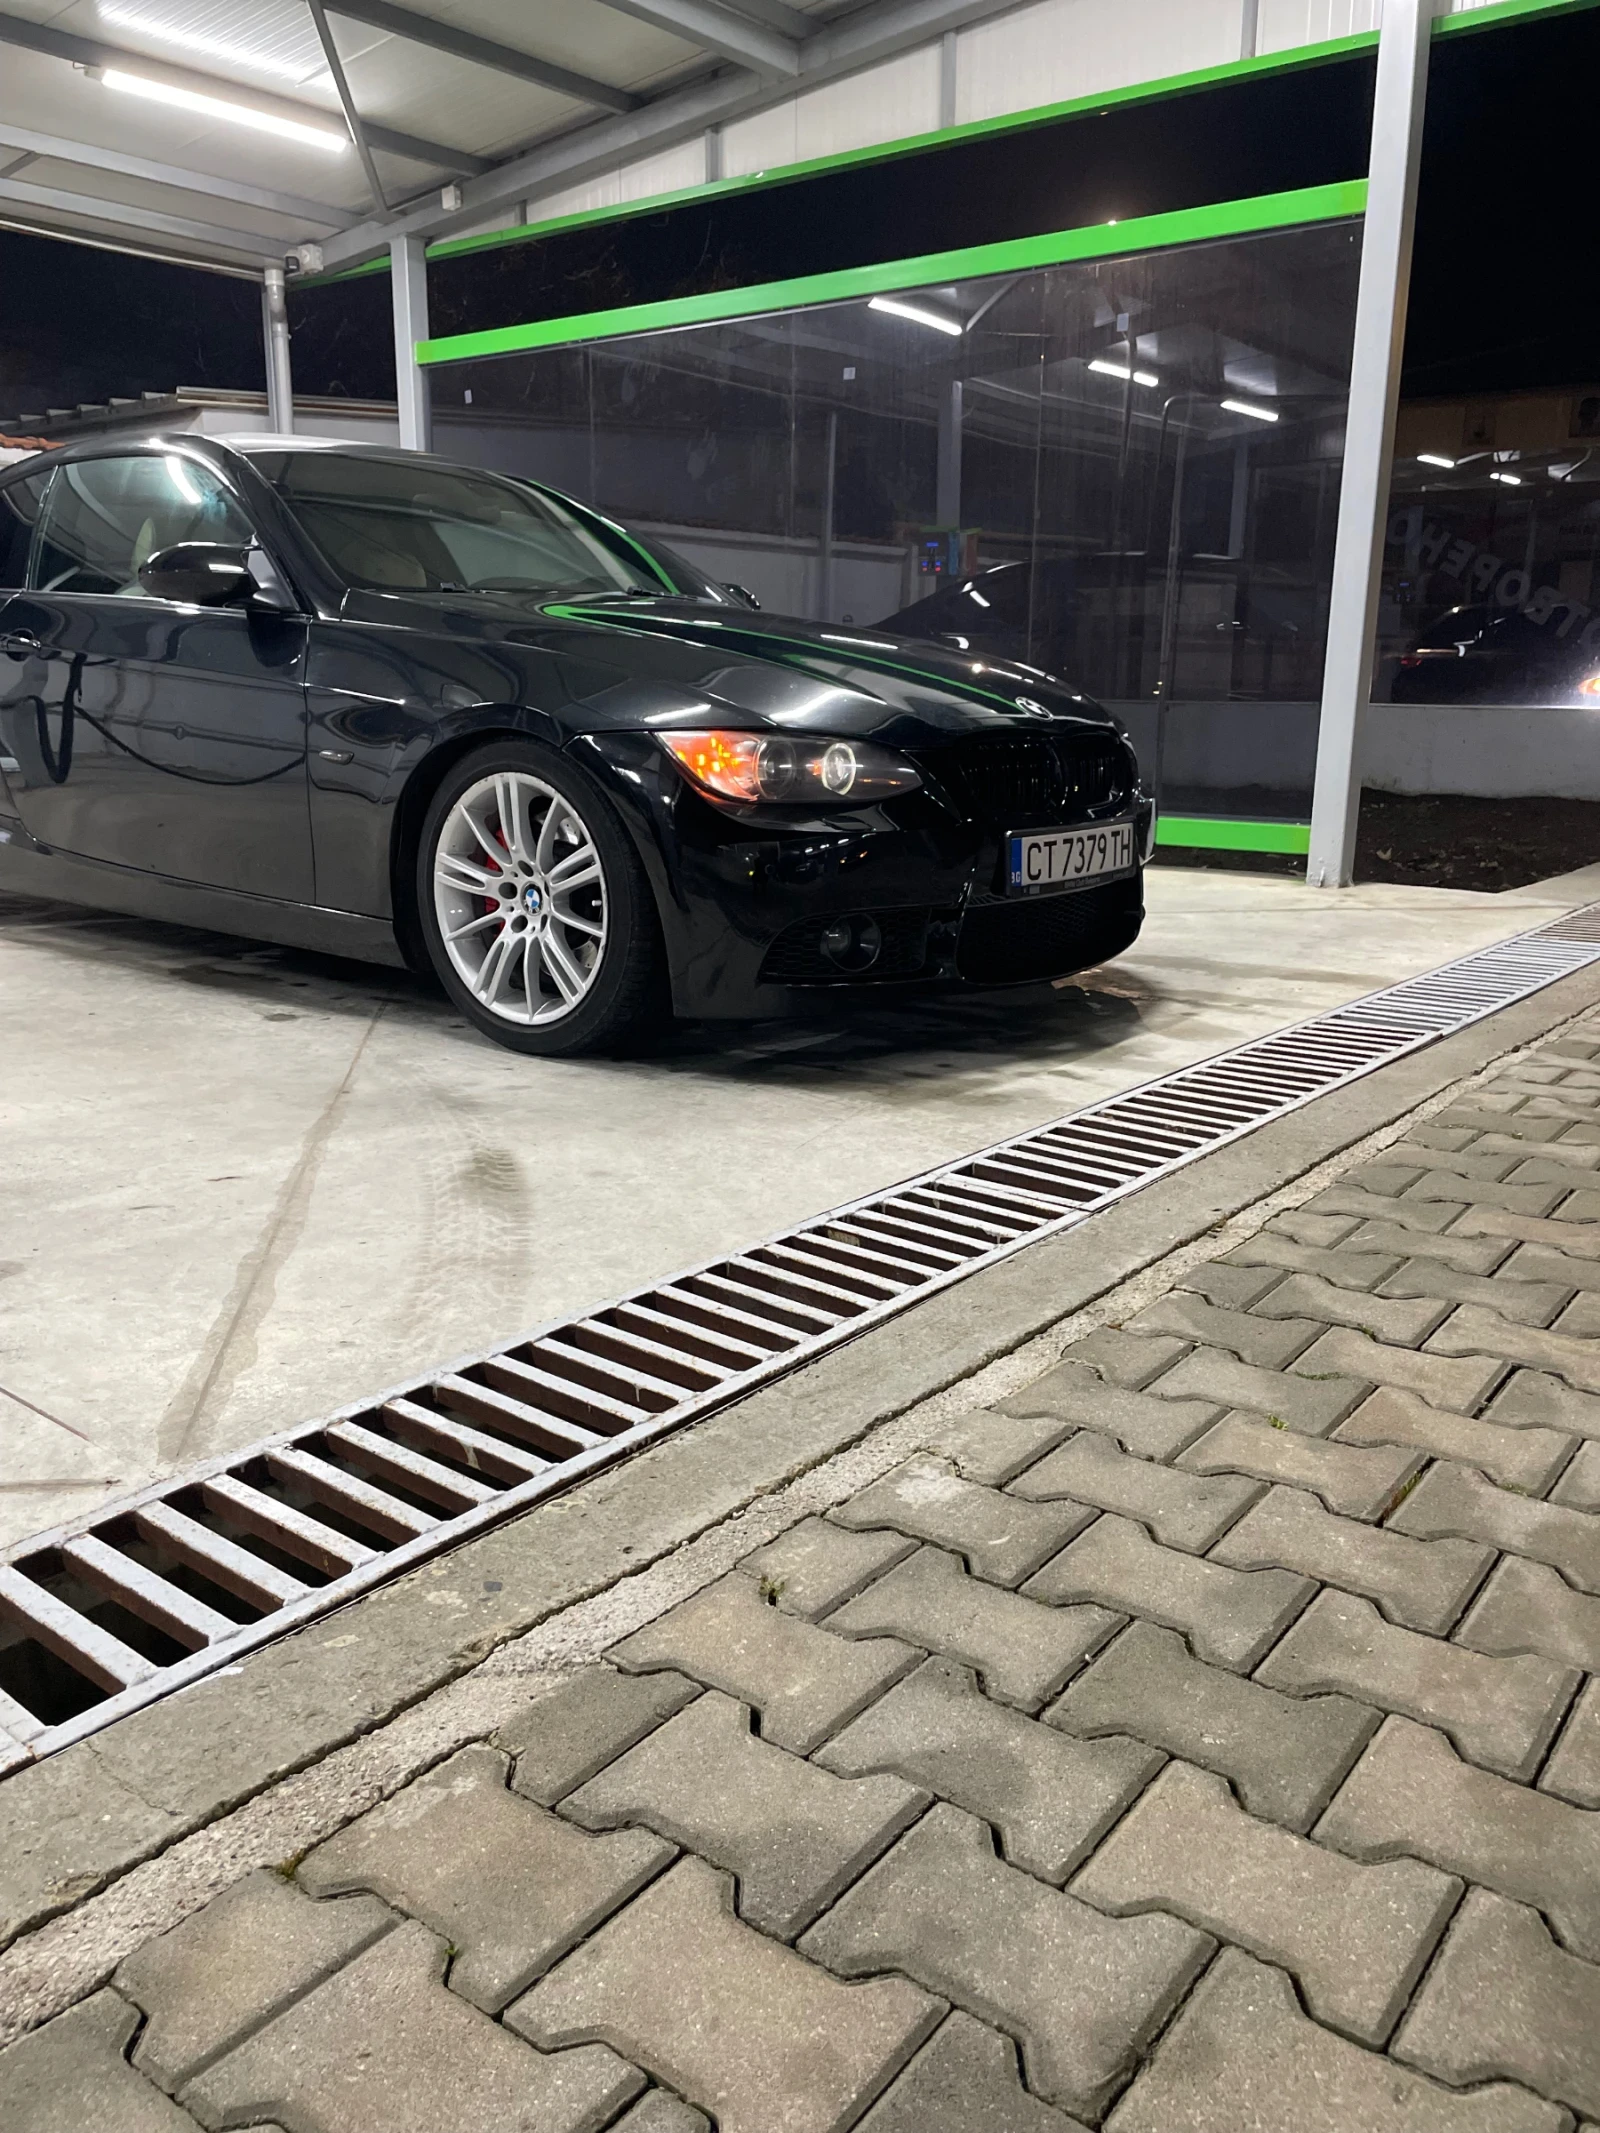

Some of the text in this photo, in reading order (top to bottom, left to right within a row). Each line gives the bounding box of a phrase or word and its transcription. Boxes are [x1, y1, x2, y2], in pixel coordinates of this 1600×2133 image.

[1027, 828, 1131, 880] CT 7379 TH
